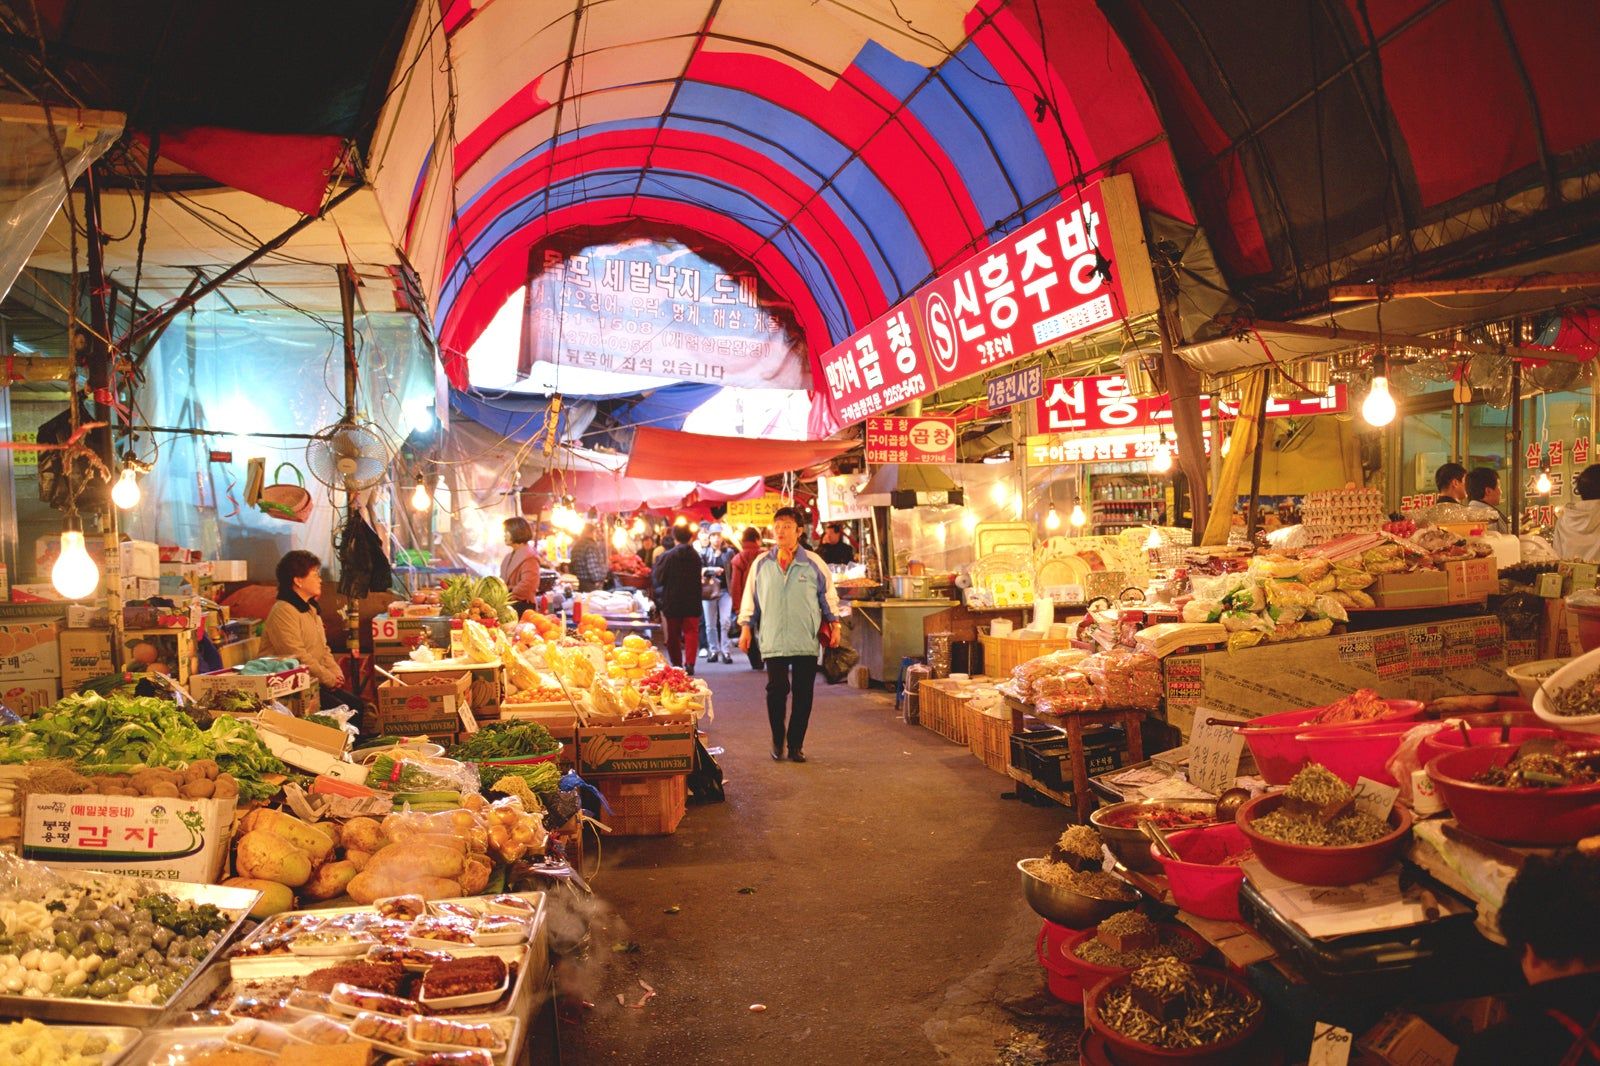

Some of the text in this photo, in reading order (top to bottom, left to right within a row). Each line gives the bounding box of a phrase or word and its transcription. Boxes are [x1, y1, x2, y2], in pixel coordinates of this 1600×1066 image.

[953, 201, 1105, 343] 신흥주방
[602, 259, 700, 302] 세발낙지
[711, 273, 758, 308] 도매
[855, 311, 917, 391] 곱창
[565, 348, 726, 380] 뒤쪽에 좌석 있습니다
[988, 367, 1040, 407] 2층전시장
[868, 419, 909, 431] 소곱창
[868, 434, 909, 447] 구이곱창
[912, 428, 950, 445] 곱창
[868, 450, 909, 463] 야채곱창
[1526, 437, 1589, 469] 삼겹살
[384, 722, 419, 733] BANANAS
[612, 759, 687, 770] PREMIUM BANANAS
[70, 803, 135, 819] (메밀꽃동네)
[42, 820, 71, 832] 봉평
[41, 831, 70, 844] 용평
[77, 825, 159, 849] 감자
